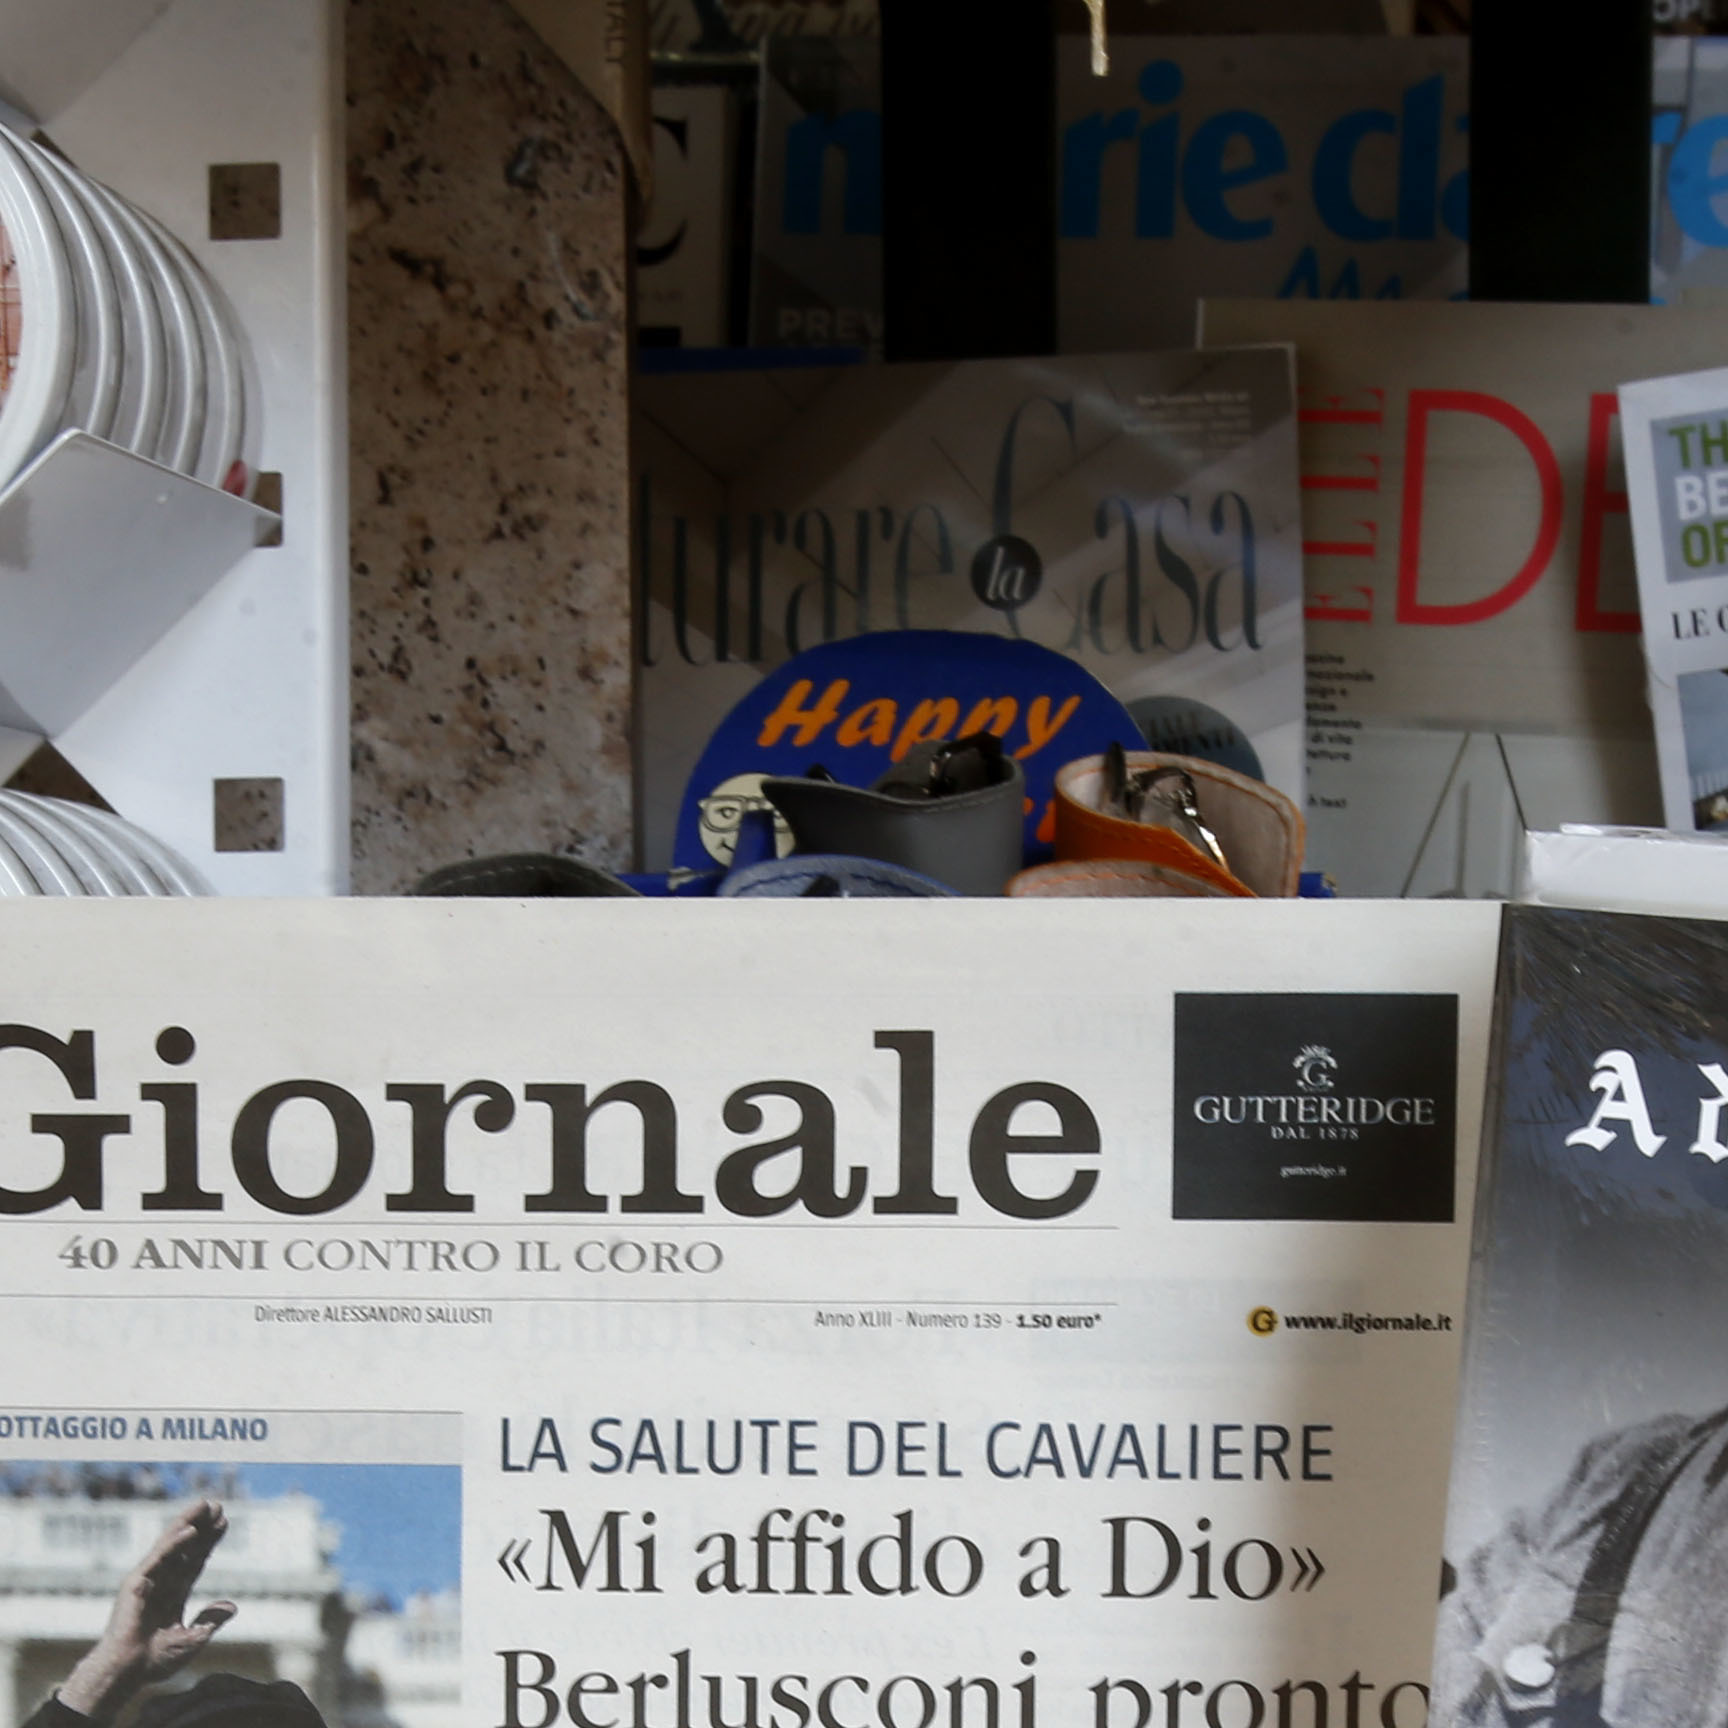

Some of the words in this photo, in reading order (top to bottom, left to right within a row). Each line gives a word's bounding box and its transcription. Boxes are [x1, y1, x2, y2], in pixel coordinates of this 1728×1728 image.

[1672, 610, 1711, 642] LE
[758, 677, 1081, 761] Happy
[58, 1236, 120, 1273] 40
[131, 1238, 270, 1273] ANNI
[280, 1237, 499, 1276] CONTRO
[515, 1240, 562, 1275] IL
[573, 1239, 725, 1277] CORO
[1284, 1309, 1453, 1337] www.ilgiornale.it
[133, 1415, 154, 1442] A
[160, 1414, 269, 1443] MILANO
[499, 1416, 569, 1474] LA
[589, 1417, 819, 1479] SALUTE
[844, 1420, 962, 1480] DEL
[985, 1420, 1336, 1484] CAVALIERE
[495, 1507, 660, 1596] «Mi
[692, 1507, 986, 1600] affido
[1018, 1541, 1070, 1600] a
[1100, 1512, 1328, 1602] Dio»
